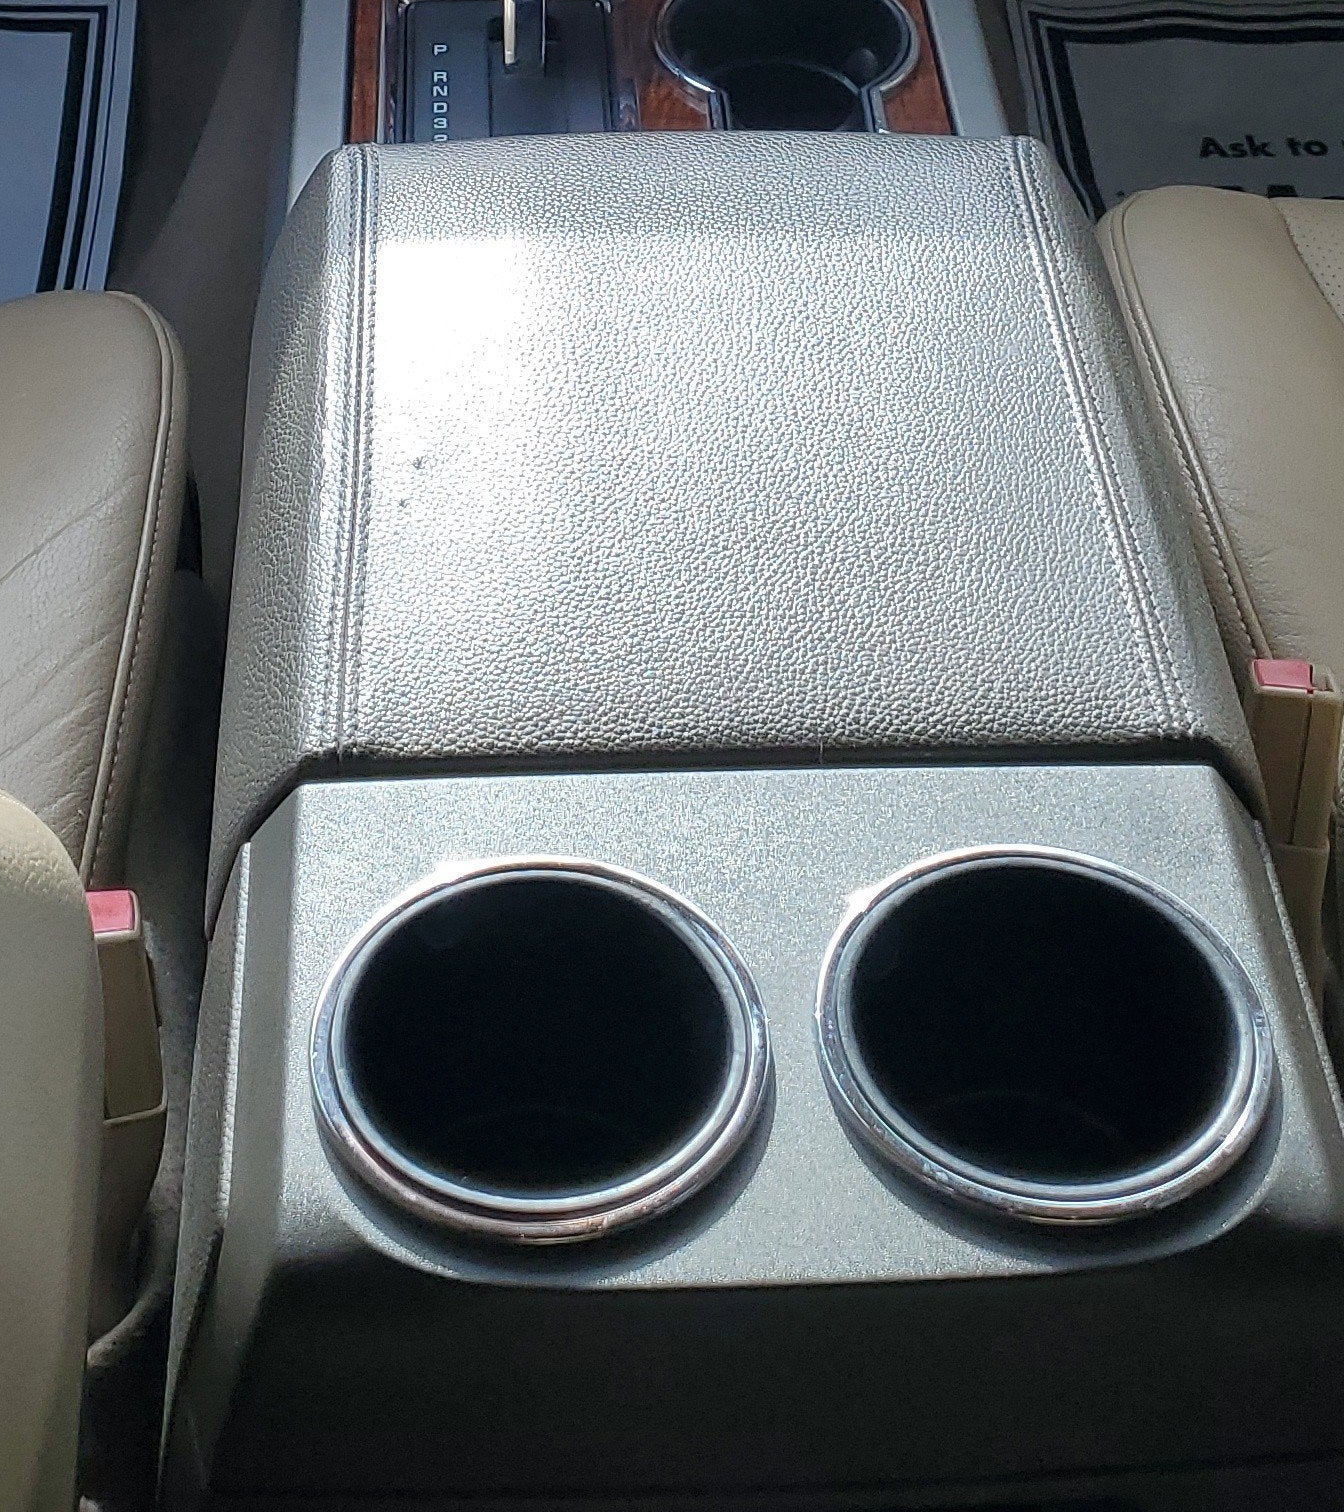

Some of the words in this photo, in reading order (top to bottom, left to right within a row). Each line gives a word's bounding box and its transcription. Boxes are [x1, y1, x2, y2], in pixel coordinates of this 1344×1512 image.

[432, 44, 447, 56] P
[433, 71, 447, 83] R
[432, 86, 448, 97] N
[433, 102, 448, 114] D
[433, 117, 447, 129] 3
[1198, 134, 1276, 159] Ask
[1286, 136, 1330, 157] to
